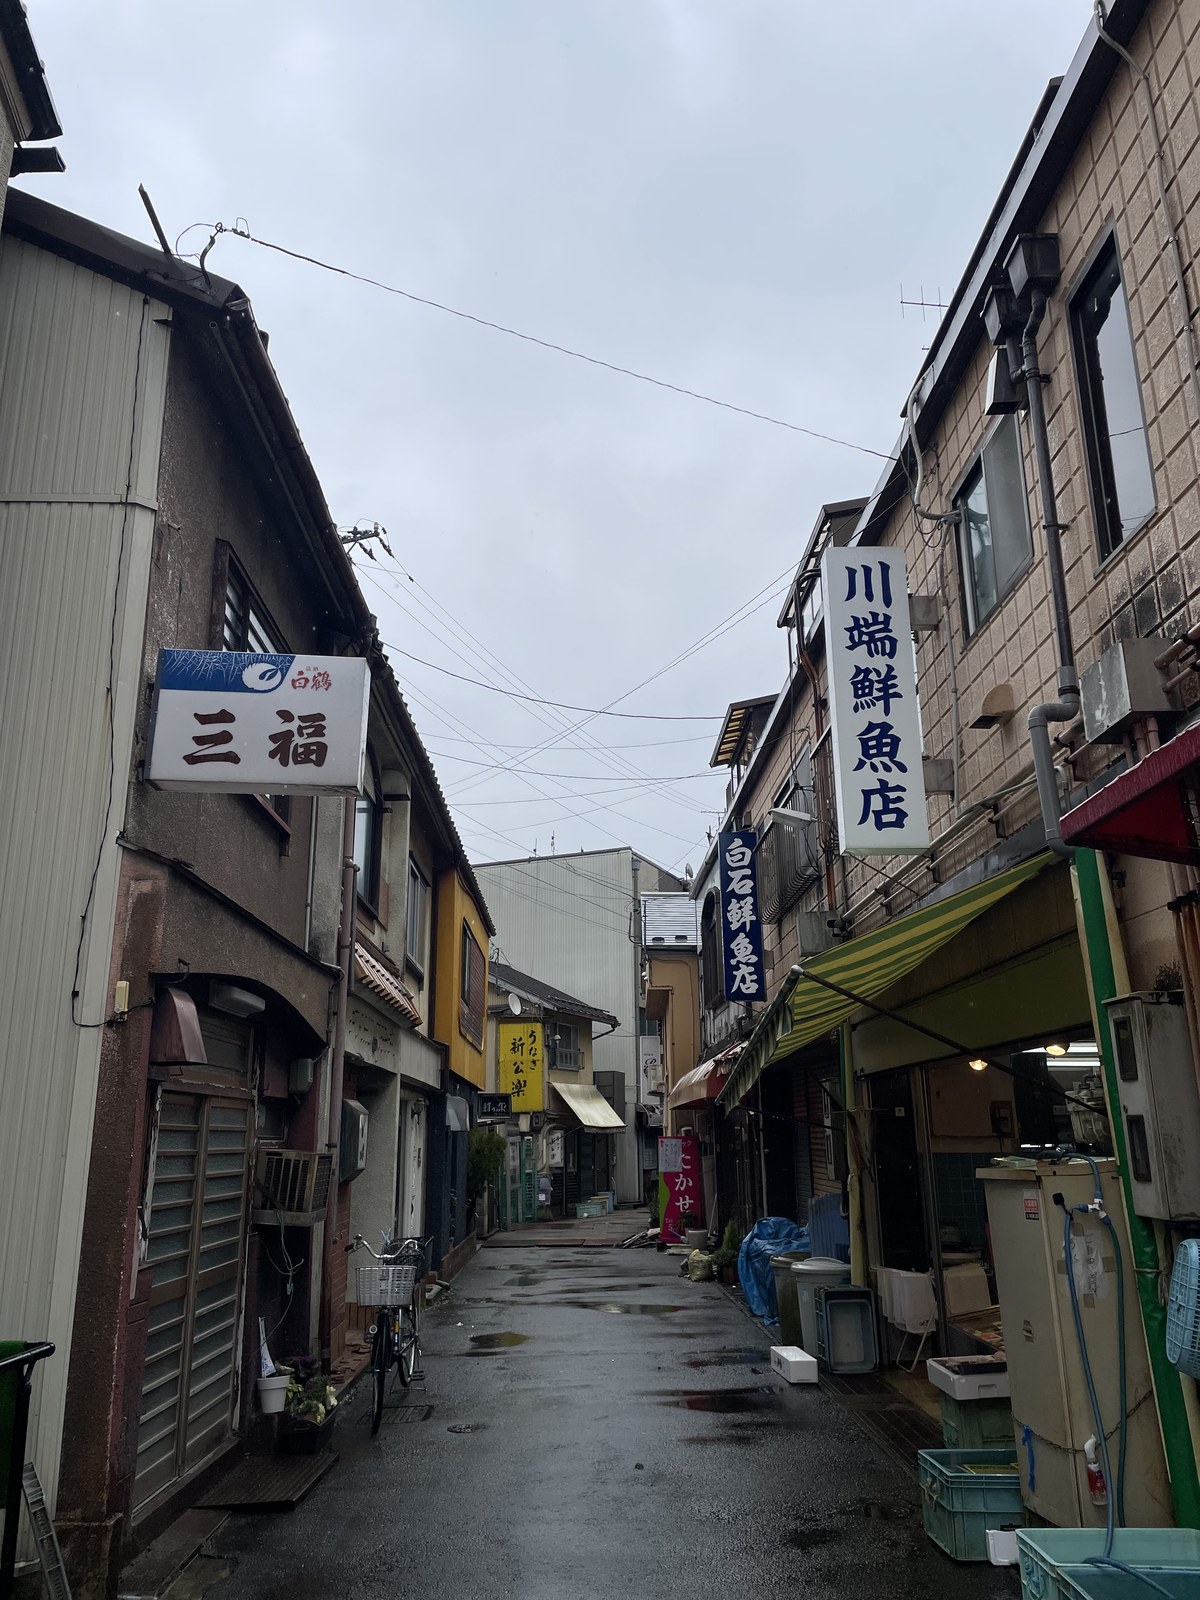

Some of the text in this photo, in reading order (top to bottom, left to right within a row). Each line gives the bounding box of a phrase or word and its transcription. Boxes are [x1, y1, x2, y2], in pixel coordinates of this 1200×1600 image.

[291, 671, 332, 691] 白鶴
[844, 561, 908, 831] 川端鮮魚店
[183, 709, 328, 767] 三福
[725, 837, 759, 994] 白石鮮魚店
[529, 1030, 539, 1070] うなぎ
